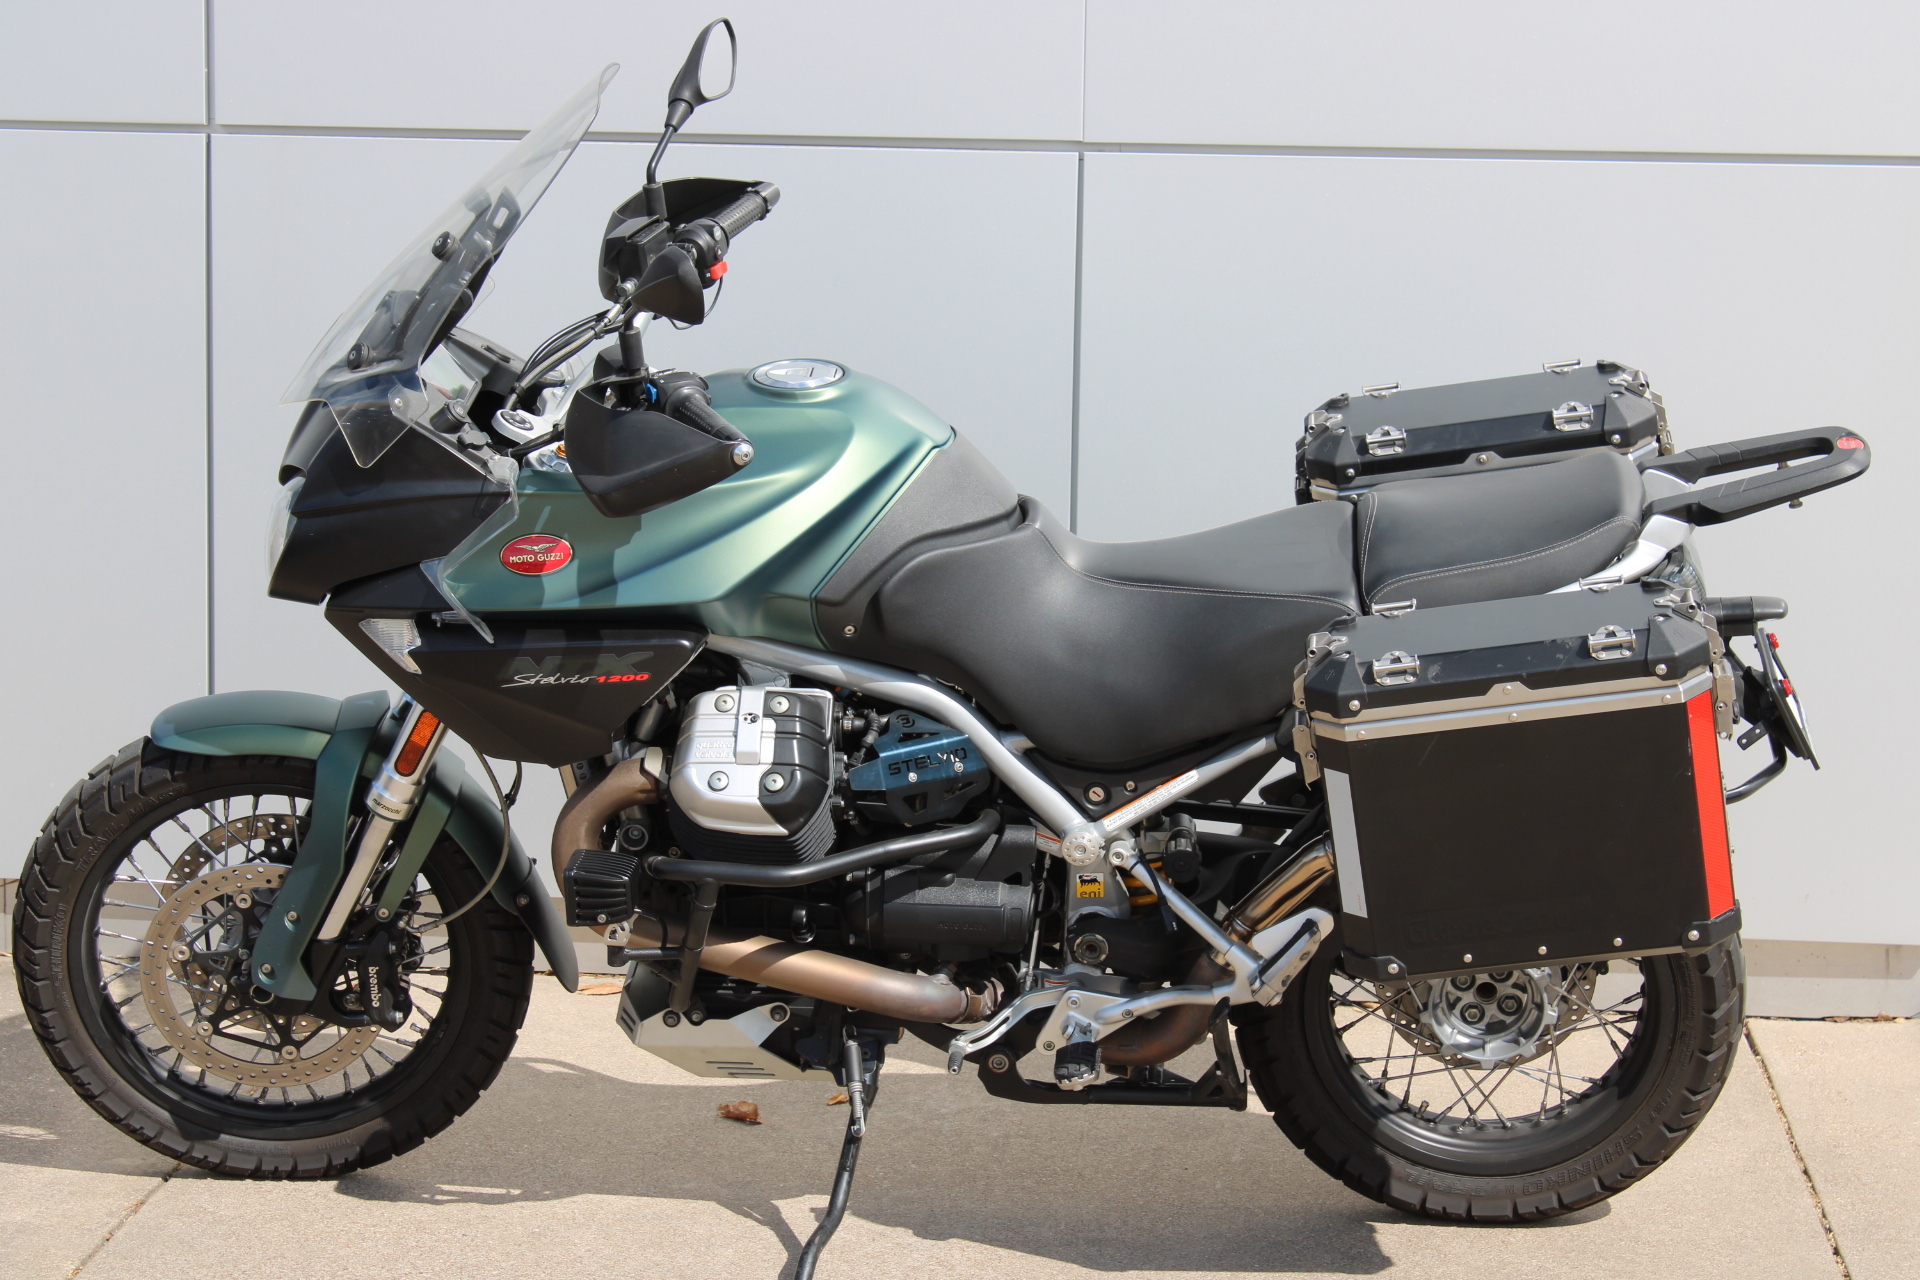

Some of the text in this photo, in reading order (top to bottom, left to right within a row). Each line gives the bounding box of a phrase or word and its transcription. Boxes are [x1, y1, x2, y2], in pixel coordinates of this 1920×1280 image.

[509, 552, 564, 564] MOTO GUZZI
[501, 672, 651, 688] Stelvio 1200
[695, 740, 734, 750] quattro
[888, 747, 968, 776] STELVIO
[371, 797, 402, 815] marzocchi
[1079, 888, 1101, 898] eni
[368, 966, 382, 1008] brembo
[1523, 1126, 1643, 1197] SHINKO
